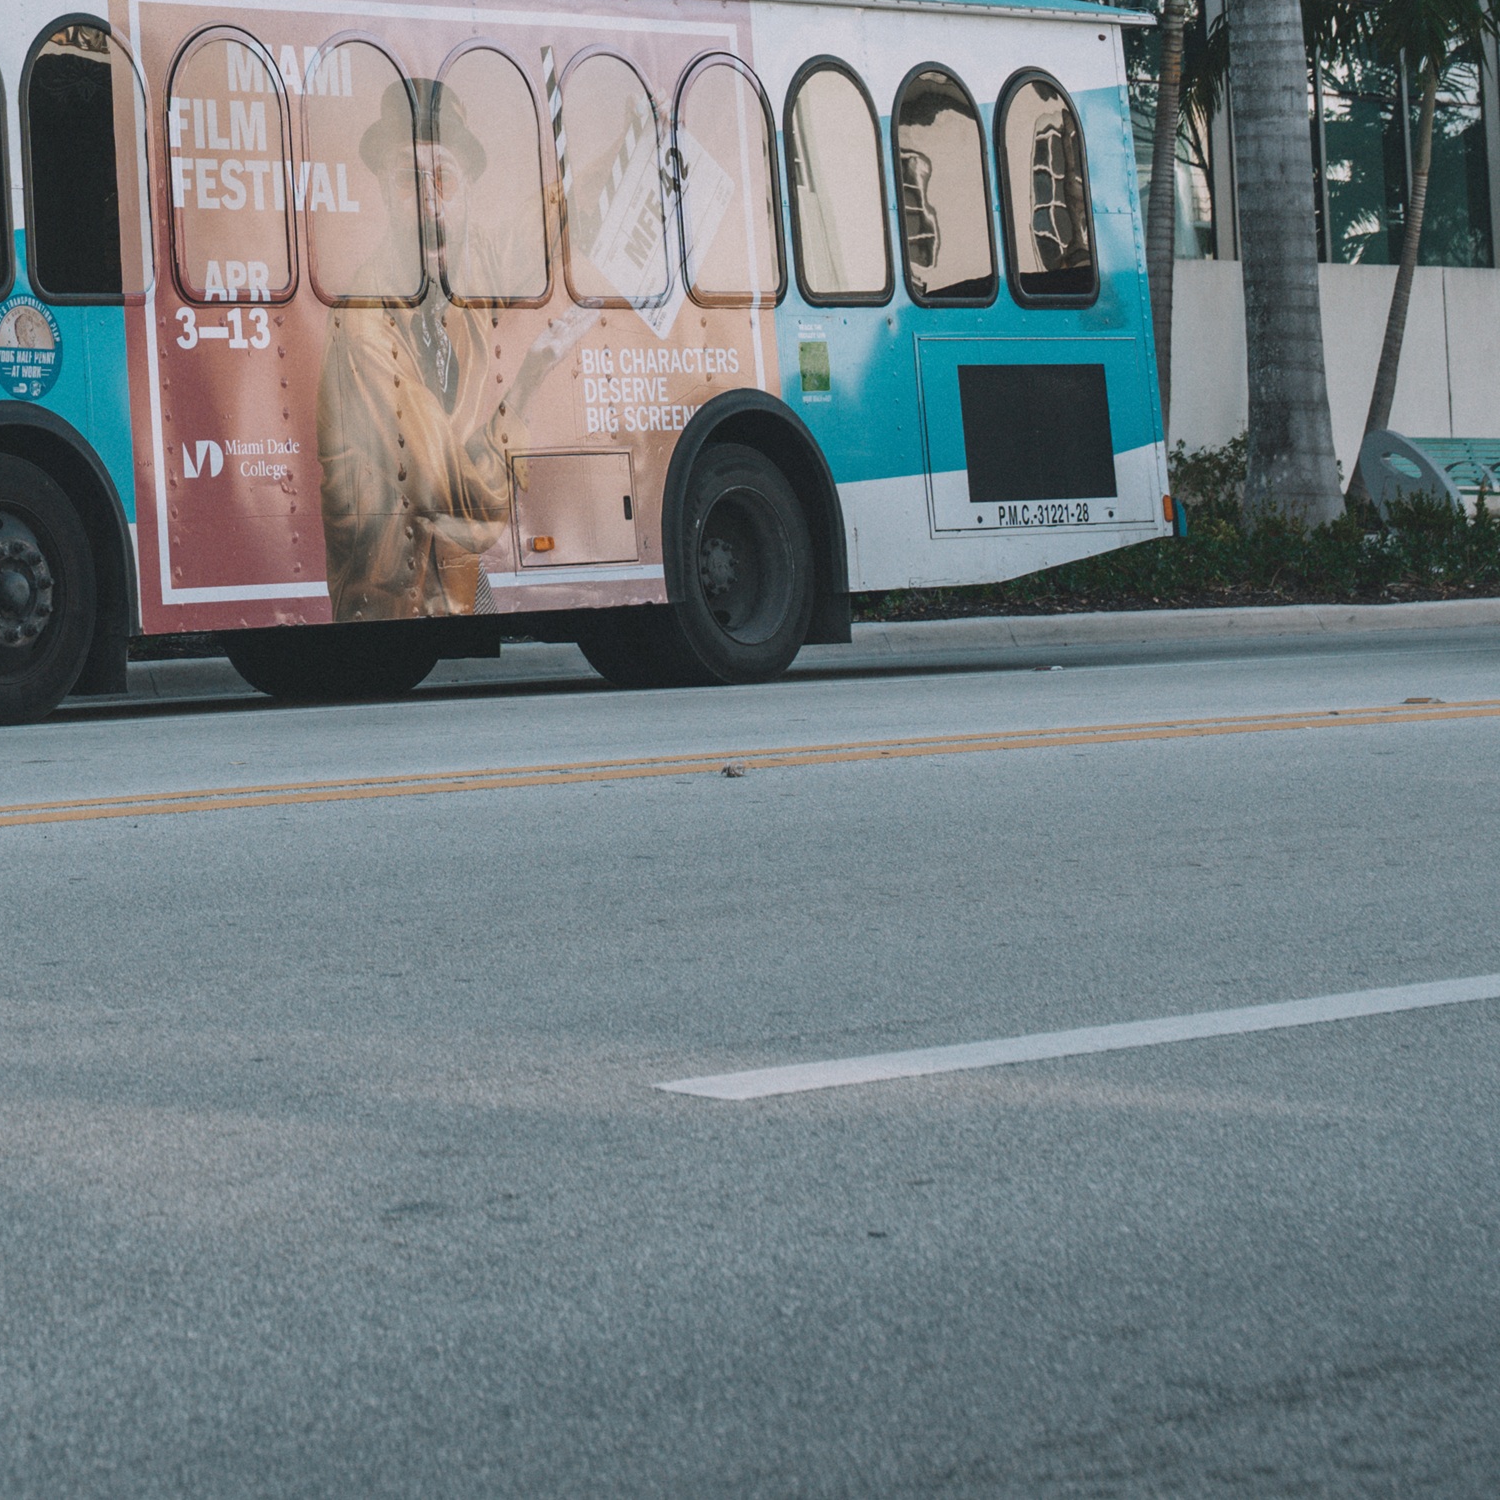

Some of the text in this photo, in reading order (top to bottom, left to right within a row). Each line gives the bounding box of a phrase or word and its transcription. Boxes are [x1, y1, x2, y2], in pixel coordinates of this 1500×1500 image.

[226, 41, 353, 97] MIAMI
[170, 97, 267, 151] FILM
[171, 157, 360, 213] FESTIVAL
[204, 260, 271, 301] APR
[16, 351, 32, 363] HALF
[34, 352, 55, 364] PENNY
[581, 348, 740, 374] BIG CHARACTERS
[11, 365, 42, 378] AT WORK
[583, 377, 669, 403] DESERVE
[587, 404, 703, 432] BIG SCREEN
[225, 439, 264, 455] Miami
[267, 437, 300, 454] Dade
[240, 460, 288, 480] College
[998, 502, 1090, 526] P.M.C.-31221-28
